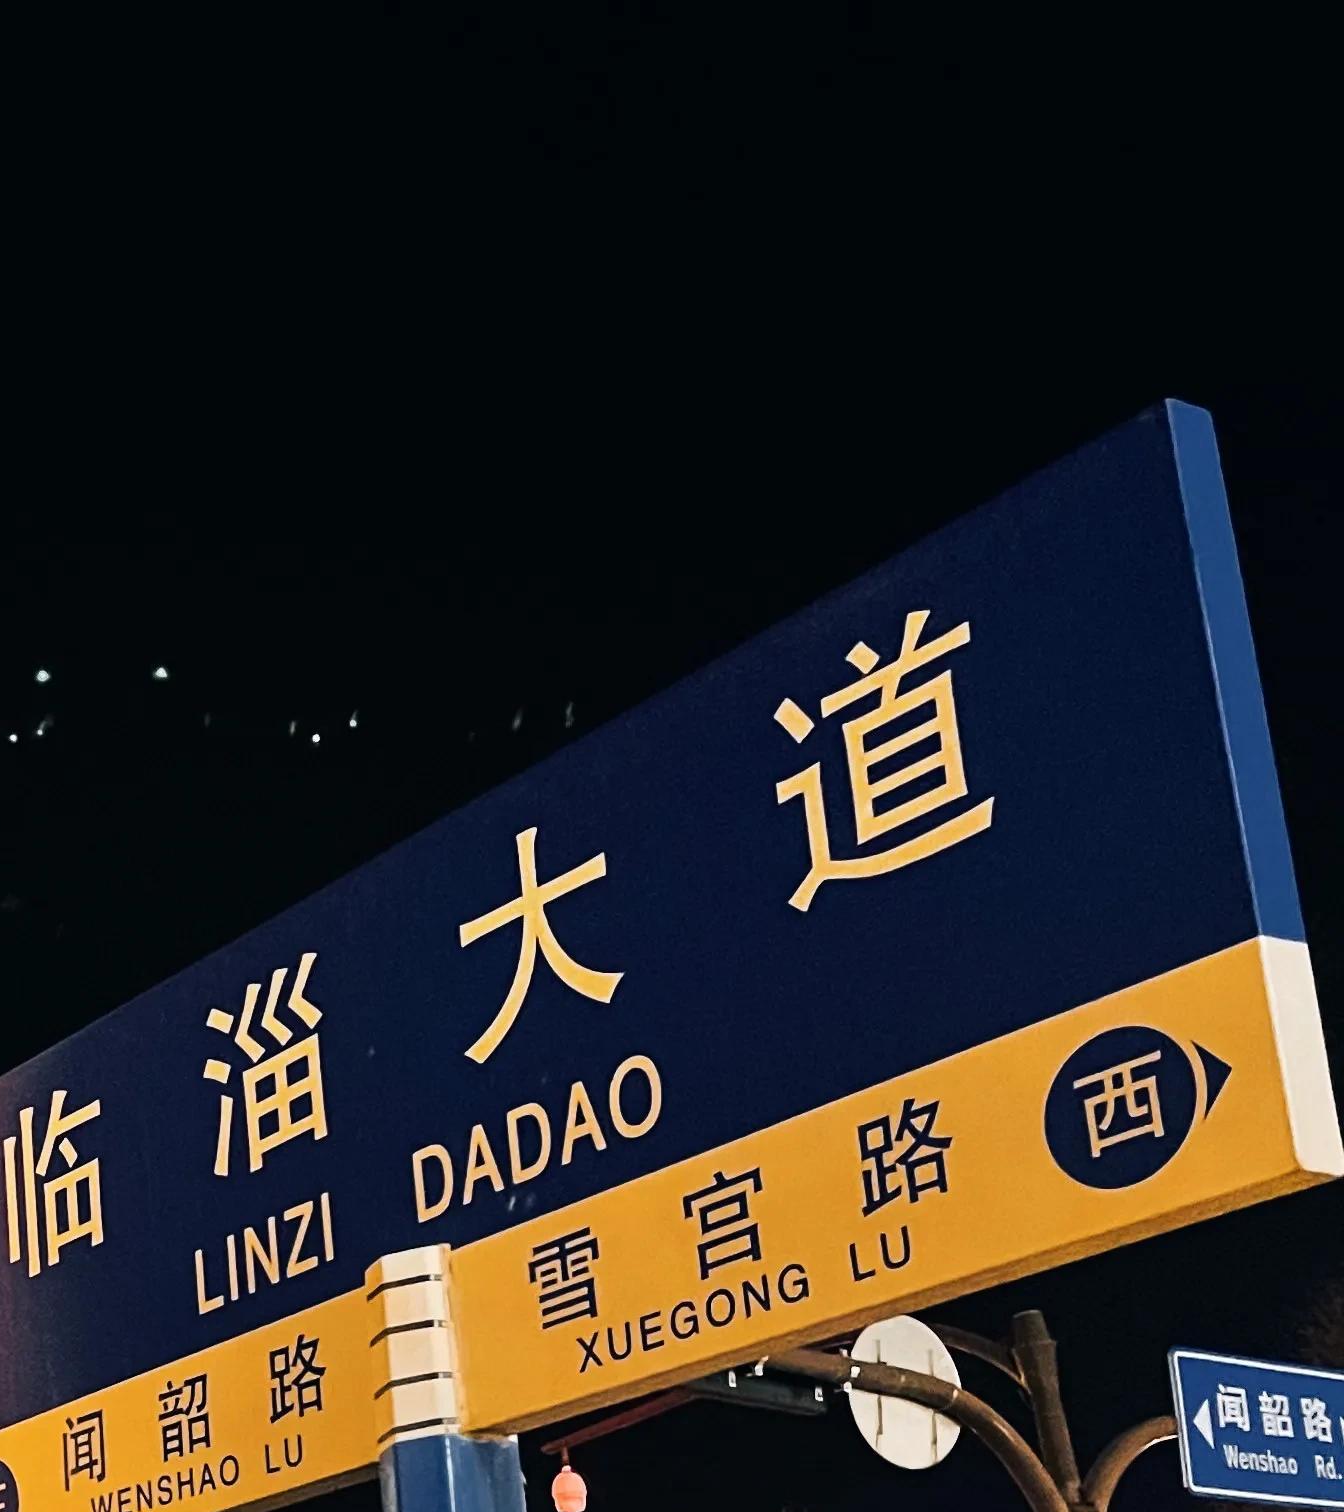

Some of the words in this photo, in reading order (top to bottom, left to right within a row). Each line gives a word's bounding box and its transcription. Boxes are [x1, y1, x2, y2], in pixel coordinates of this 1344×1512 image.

[4, 610, 994, 1277] 临淄大道
[1073, 1050, 1164, 1157] 西
[195, 1193, 334, 1314] LINZI
[413, 1055, 661, 1223] DADAO
[528, 1099, 952, 1329] 雪宫路
[576, 1264, 809, 1373] XUEGONG
[850, 1226, 910, 1281] LU
[63, 1334, 326, 1490] 闻韶路
[265, 1435, 302, 1473] LU
[1217, 1384, 1332, 1442] 闻韶路
[1223, 1445, 1297, 1474] Wenshao
[1315, 1455, 1343, 1479] Rd.
